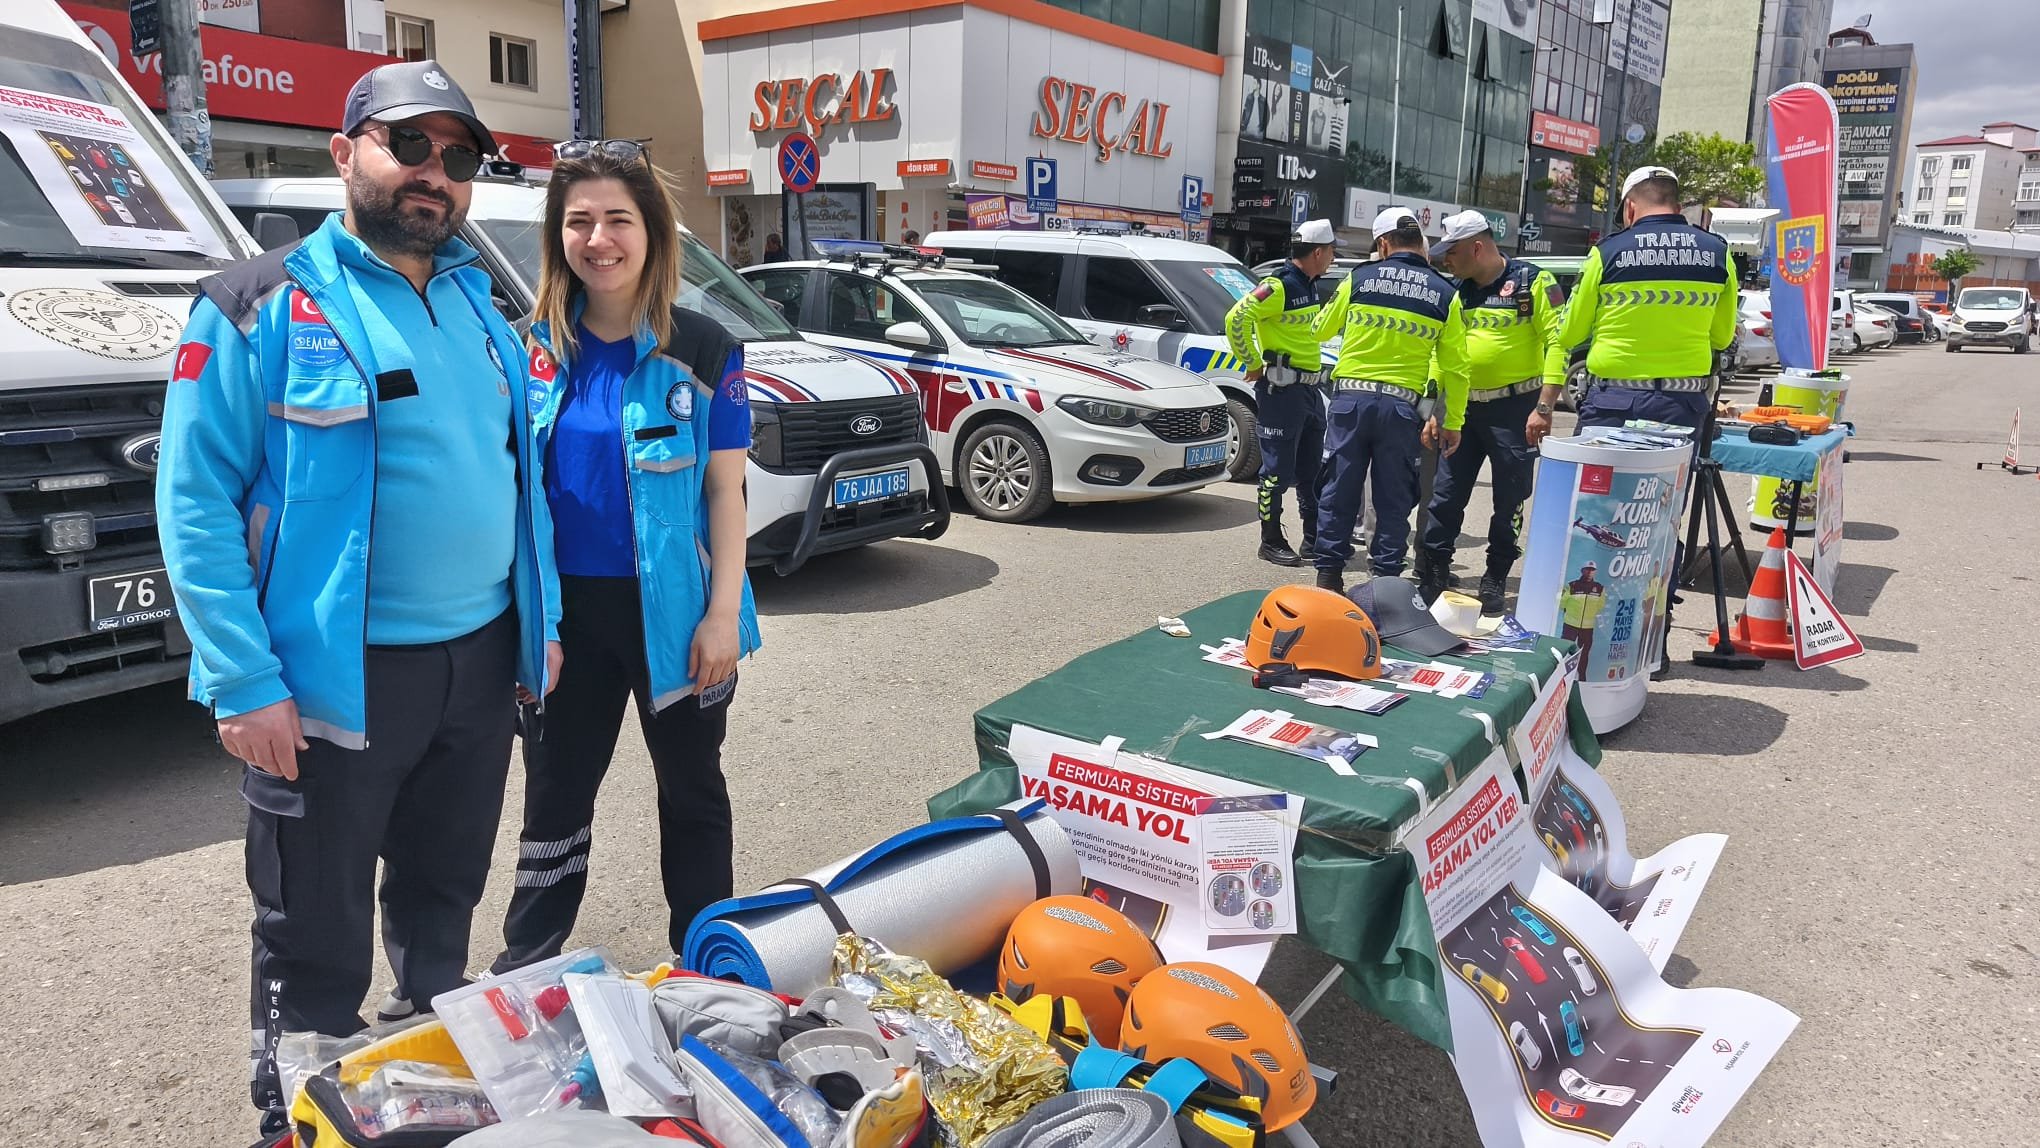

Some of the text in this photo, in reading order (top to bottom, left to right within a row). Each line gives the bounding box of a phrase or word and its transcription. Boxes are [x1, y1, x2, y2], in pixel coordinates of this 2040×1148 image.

[1253, 46, 1268, 68] LTB
[1827, 82, 1898, 96] SİKOTEKNİK
[1837, 70, 1878, 83] DOĞU
[0, 95, 60, 114] AŞAMA
[751, 68, 897, 138] SEÇAL
[1868, 96, 1895, 104] MERKEZİ
[1033, 76, 1173, 162] SEÇAL
[1853, 126, 1891, 138] AVUKAT
[1032, 161, 1052, 197] P
[1277, 154, 1300, 180] LTB
[1851, 171, 1885, 181] AVUKAT
[1185, 178, 1199, 208] P
[1295, 196, 1305, 222] P
[1047, 217, 1062, 229] 69
[1616, 249, 1715, 267] JANDARMASI
[1359, 279, 1440, 305] JANDARMASI
[857, 418, 877, 433] Ford
[843, 473, 906, 500] 76 JAA 185
[1611, 501, 1660, 525] KURAL
[1608, 550, 1652, 578] ÖMÜR
[114, 577, 156, 612] 76
[1616, 598, 1636, 616] 2-8
[97, 609, 171, 631] Ford OTOKOÇ
[1806, 620, 1835, 636] RADAR
[1806, 633, 1845, 650] HIZ KONTROLÜ
[1055, 761, 1197, 811] FERMUAR SİSTEM
[1021, 775, 1129, 827] YAŞAMA
[1135, 806, 1190, 845] YOL
[1471, 818, 1497, 850] YOL
[1495, 792, 1519, 829] VER!
[1072, 827, 1105, 844] şeridinin
[1105, 838, 1139, 855] olmadığı
[1150, 851, 1173, 865] yönlü
[1430, 817, 1468, 857] FERMUAR
[1071, 838, 1194, 882] yönünüze göre şeridinizin sağına
[1087, 853, 1107, 865] geçiş
[1108, 858, 1140, 875] koridoru
[1141, 869, 1181, 889] oluşturun.
[1221, 857, 1232, 865] YOL
[1233, 857, 1258, 865] YAŞAMA
[1671, 1085, 1694, 1114] güvenli
